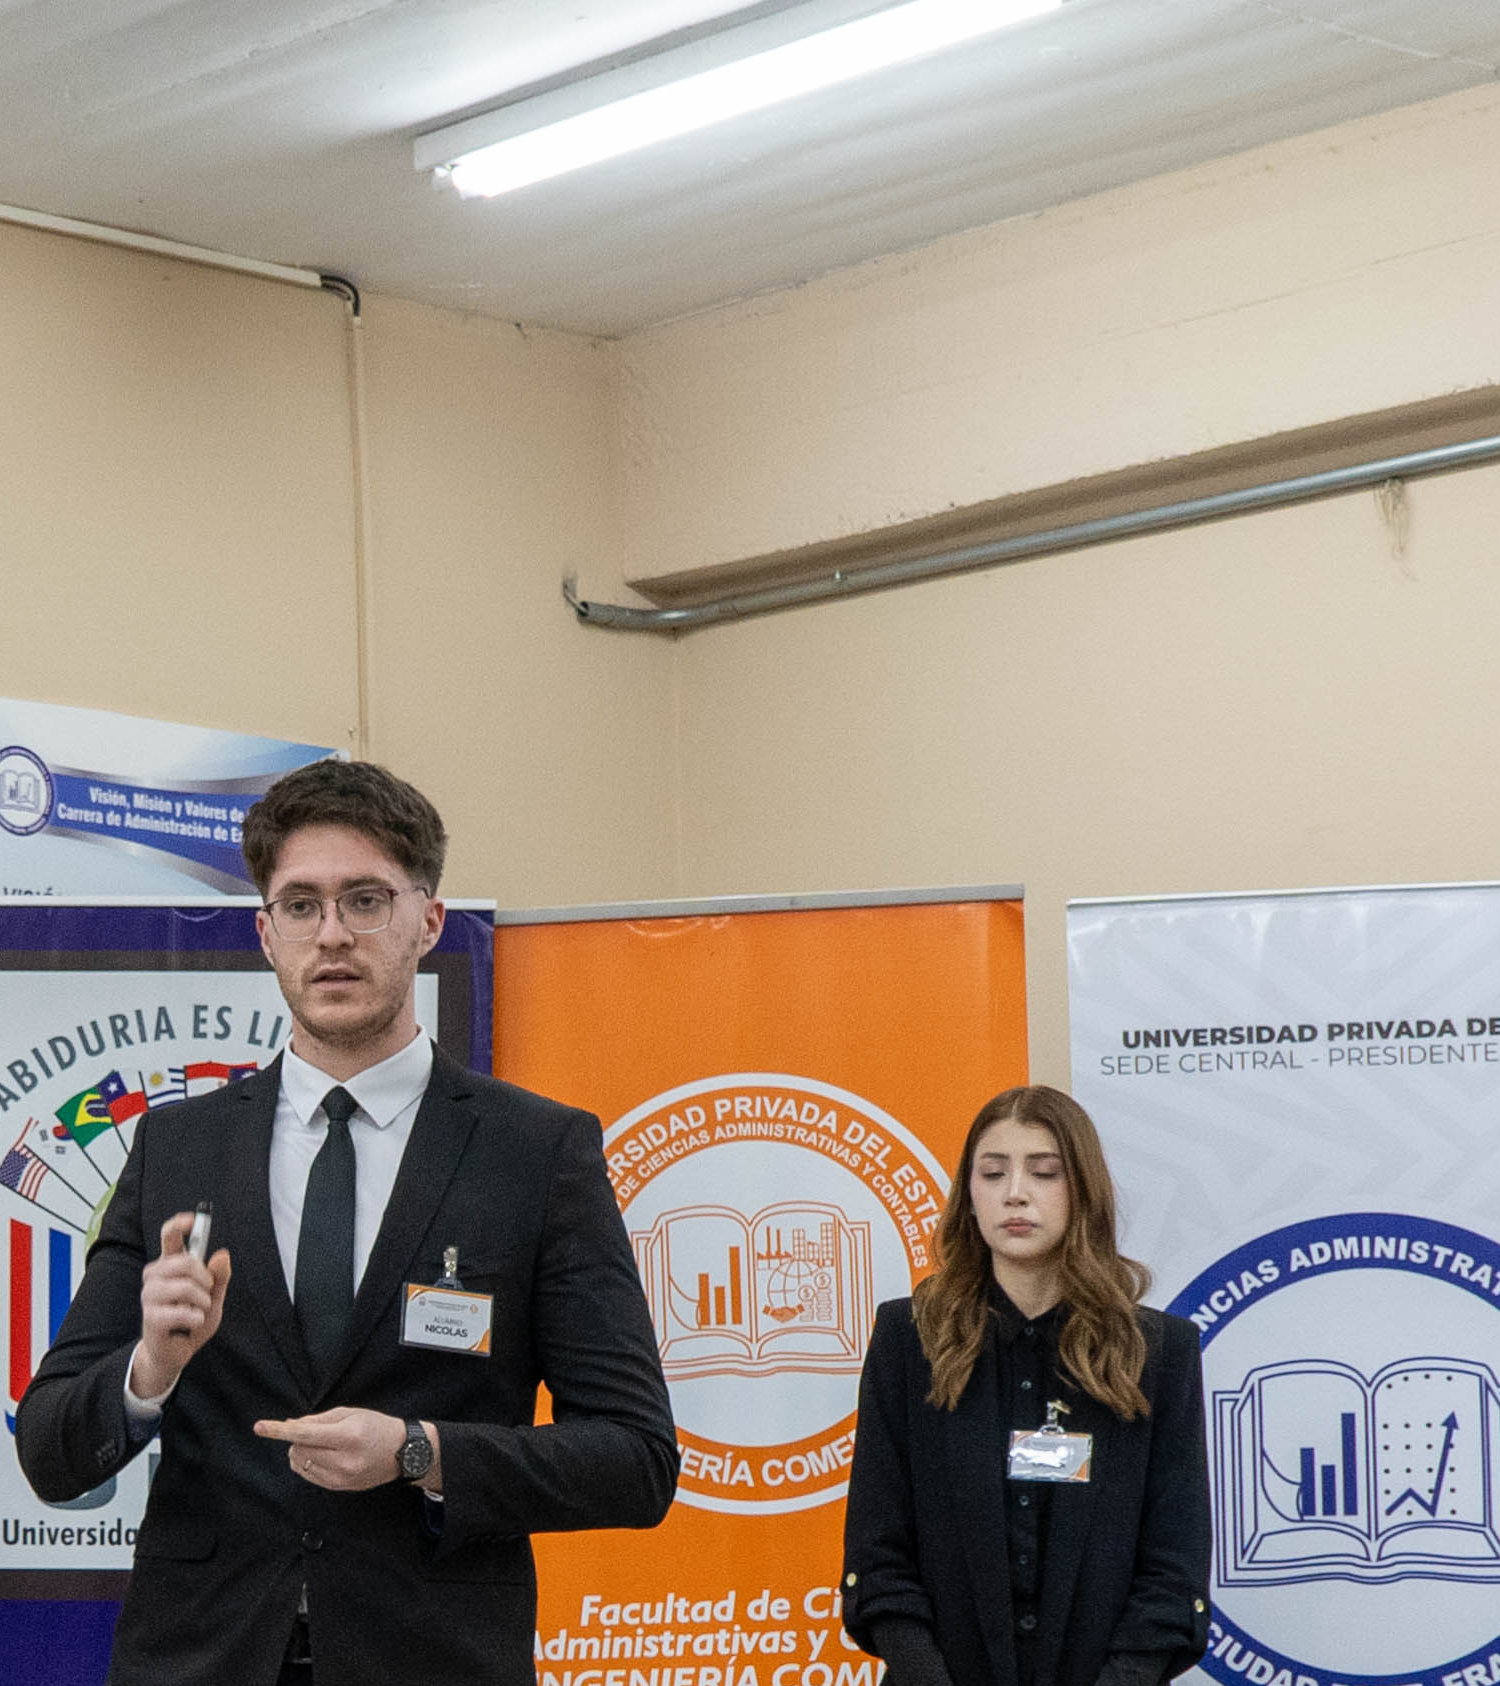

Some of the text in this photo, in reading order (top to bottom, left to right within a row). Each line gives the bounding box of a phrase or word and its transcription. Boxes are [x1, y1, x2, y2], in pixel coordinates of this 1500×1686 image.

[57, 802, 229, 842] Carrera de Administración de
[89, 786, 244, 824] Visión, Misión y Valores de
[192, 1004, 233, 1040] ES
[1122, 1024, 1319, 1050] UNIVERSIDAD
[1326, 1018, 1458, 1043] PRIVADA
[1100, 1054, 1171, 1077] SEDE
[1178, 1049, 1304, 1073] CENTRAL
[1328, 1041, 1500, 1069] PRESIDENTE
[714, 1095, 839, 1134] PRIVADA
[843, 1119, 893, 1170] DEL
[617, 1122, 928, 1268] DE CIENCIAS ADMINISTRATIVAS Y CONTABLES
[424, 1322, 468, 1338] NICOLAS
[580, 1590, 737, 1627] Facultad
[746, 1589, 791, 1620] de
[806, 1628, 829, 1661] y
